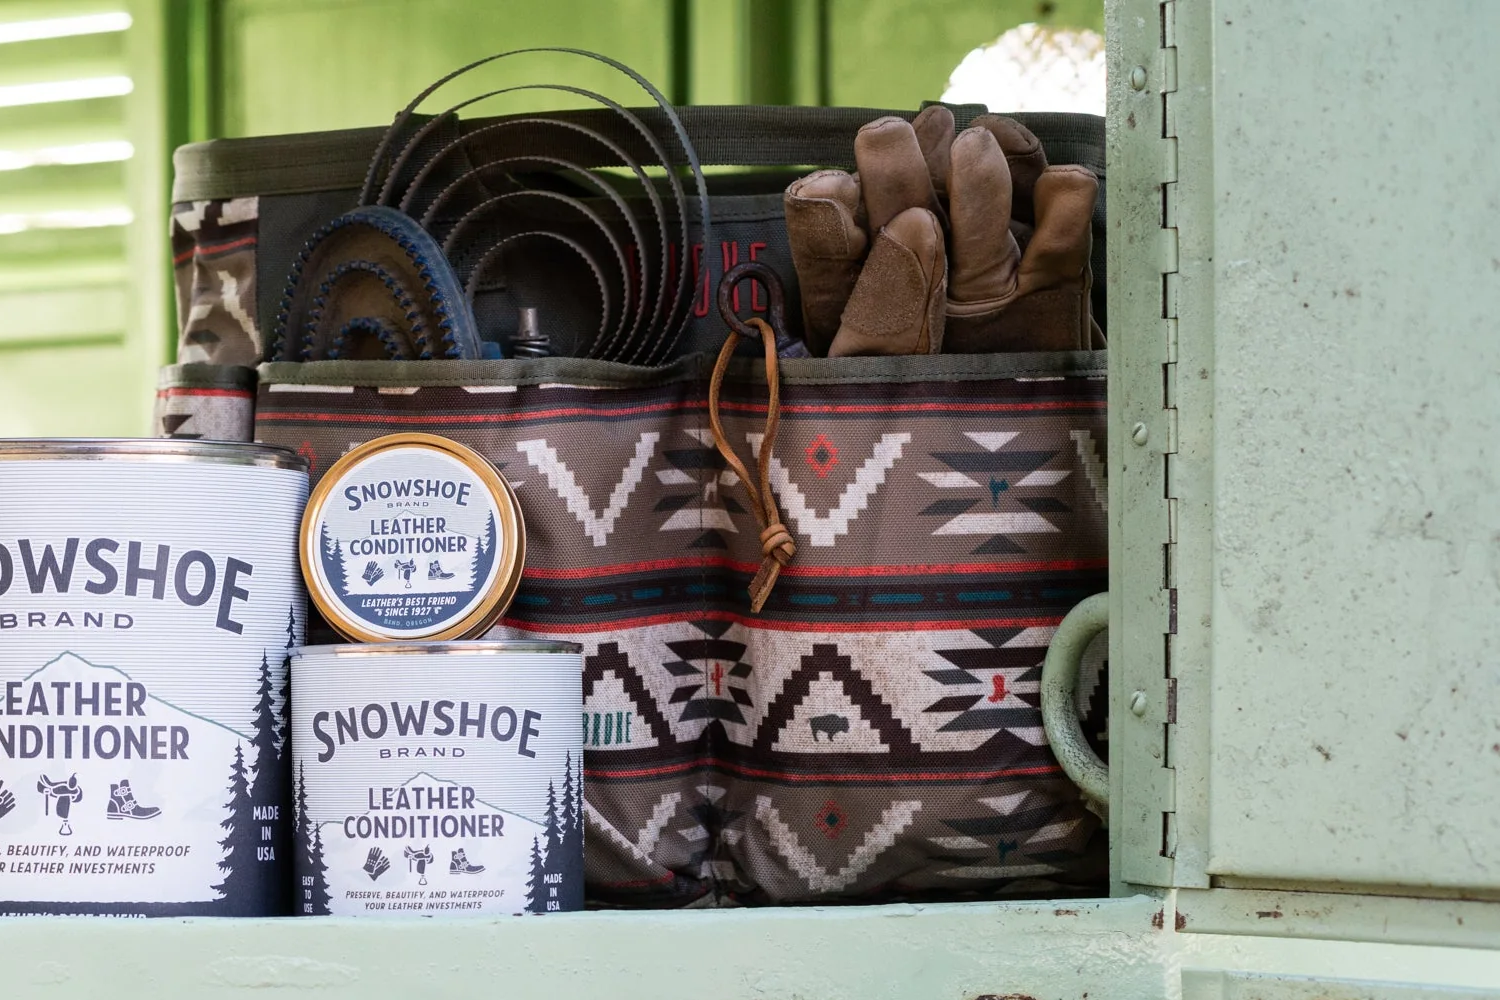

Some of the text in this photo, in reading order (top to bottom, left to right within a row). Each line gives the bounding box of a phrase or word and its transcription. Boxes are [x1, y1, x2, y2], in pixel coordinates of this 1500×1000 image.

[344, 479, 471, 511] SNOWSHOE
[370, 517, 446, 535] LEATHER
[349, 536, 467, 555] CONDITIONER
[361, 596, 457, 608] LEATHER'S BEST FRIEND
[384, 607, 431, 617] SINCE 1927
[0, 611, 134, 630] BRAND
[312, 700, 542, 763] SNOWSHOE
[380, 747, 465, 759] BRAND
[369, 786, 476, 810] LEATHER
[252, 805, 279, 821] MADE
[344, 814, 504, 839] CONDITIONER
[261, 826, 272, 841] IN
[6, 845, 69, 858] BEAUTIFY,
[74, 845, 101, 857] AND
[106, 845, 191, 857] WATERPROOF
[257, 846, 276, 861] USA
[9, 861, 65, 874] LEATHER
[68, 863, 156, 874] INVESTMENTS
[302, 875, 315, 887] EASY
[543, 873, 563, 884] MADE
[304, 889, 312, 900] TO
[345, 889, 506, 900] PRESERVE, BEAUTIFY, AND WATERPROOF
[549, 887, 558, 898] IN
[303, 903, 314, 914] USE
[365, 901, 483, 910] YOUR LEATHER INVESTMENTS
[546, 900, 561, 911] USA
